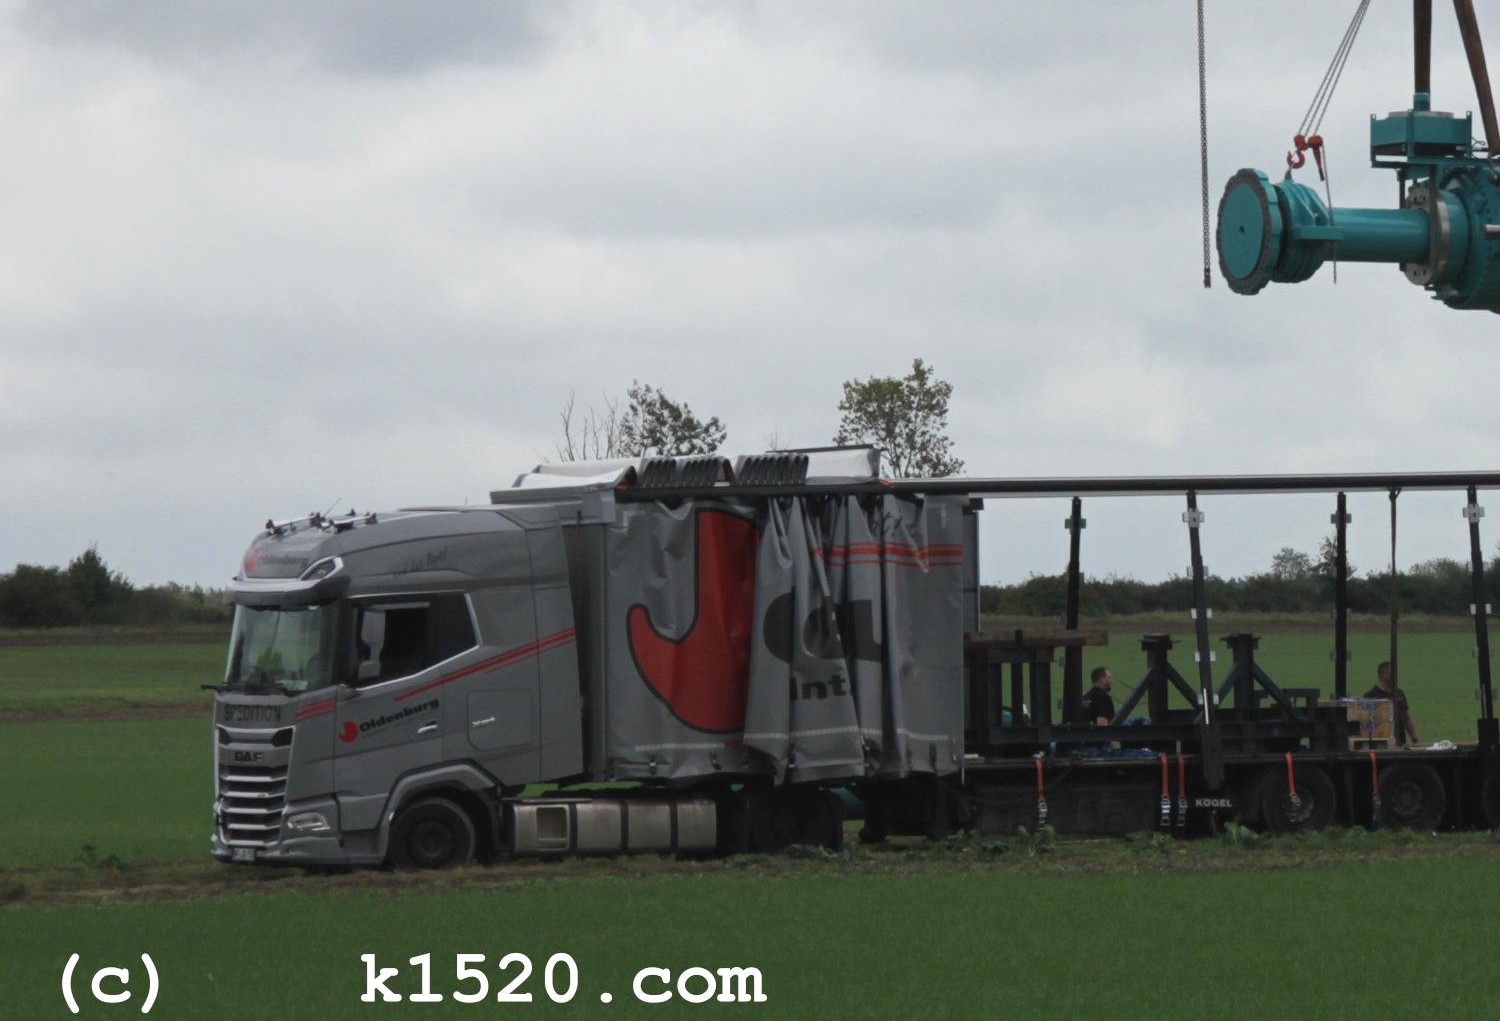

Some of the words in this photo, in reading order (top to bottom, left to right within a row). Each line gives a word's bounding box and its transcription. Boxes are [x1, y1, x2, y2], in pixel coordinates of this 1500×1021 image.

[224, 704, 282, 723] SPEDITION
[359, 699, 440, 732] Oldenburg
[235, 751, 264, 762] DAF
